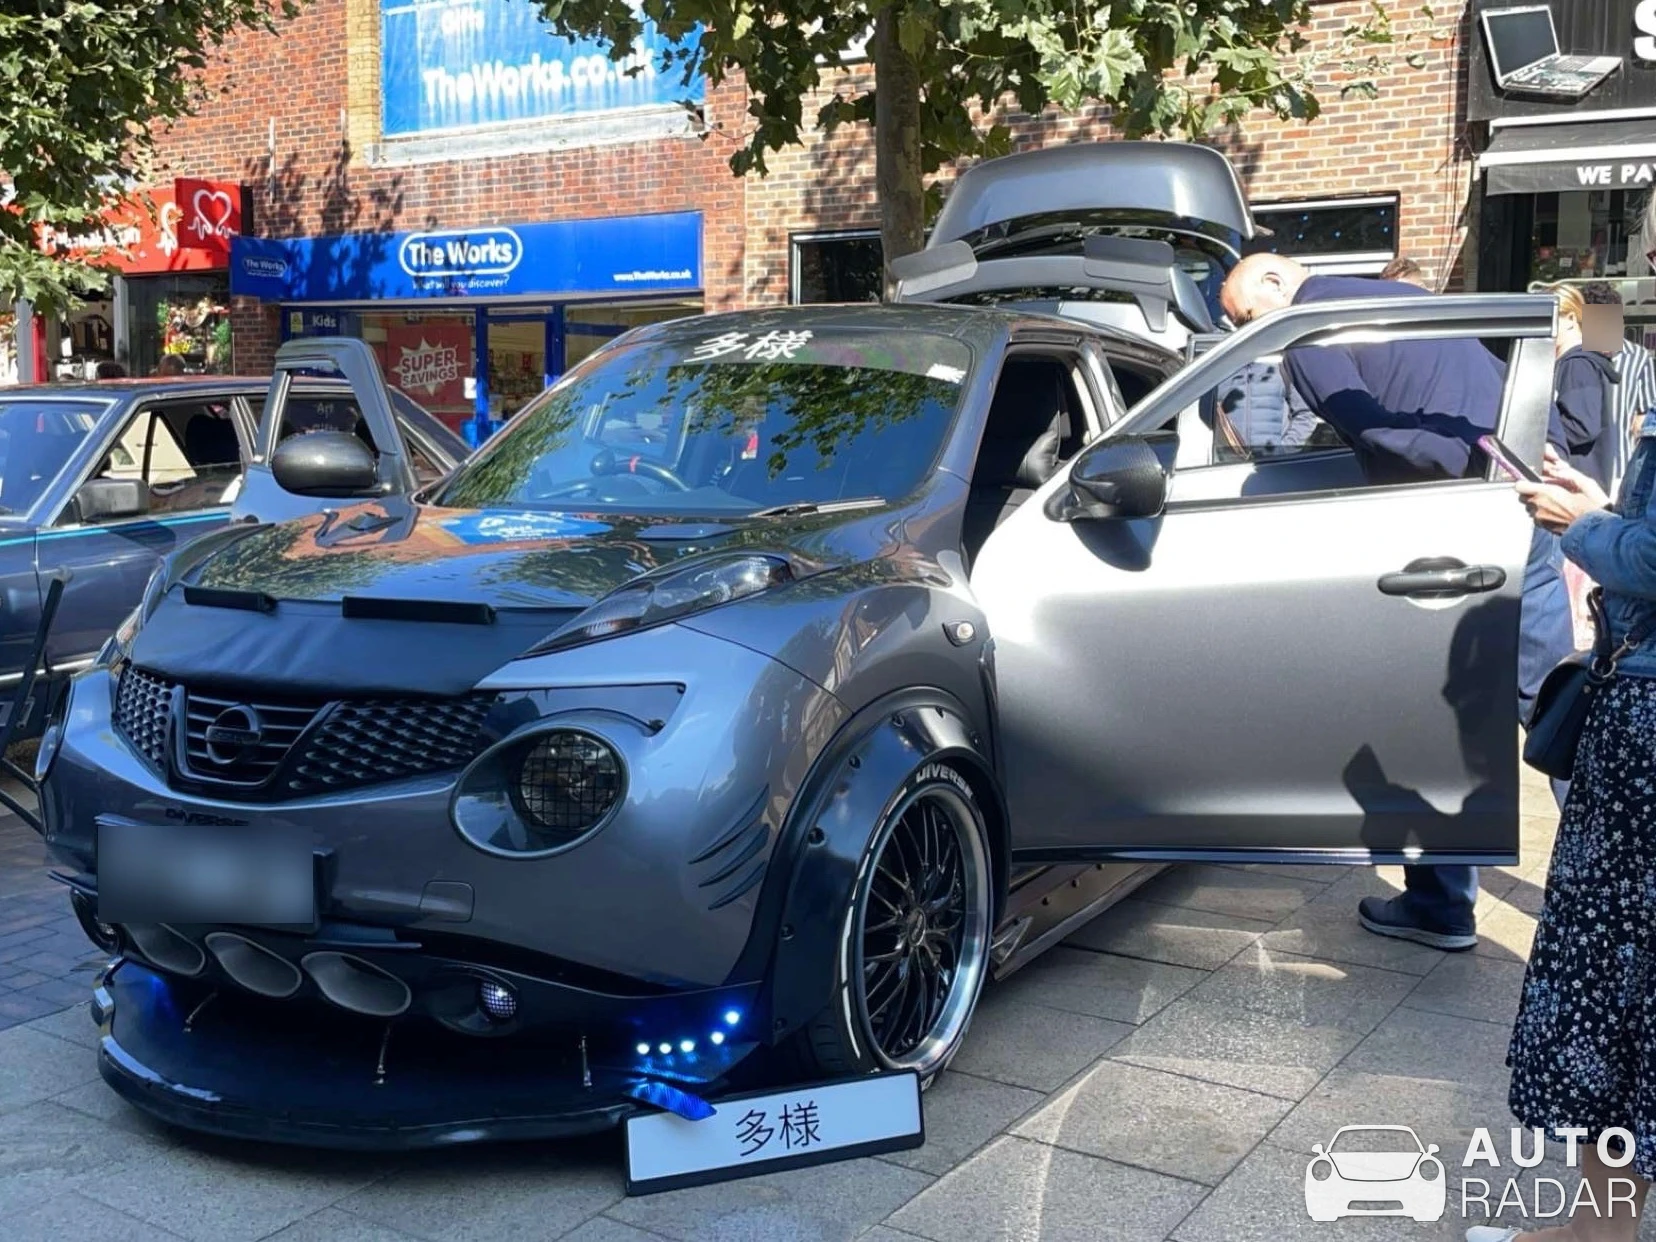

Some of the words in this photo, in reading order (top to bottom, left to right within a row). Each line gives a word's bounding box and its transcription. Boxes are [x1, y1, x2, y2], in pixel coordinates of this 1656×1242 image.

[423, 37, 655, 102] TheWorks.co.uk
[1576, 165, 1612, 185] WE
[408, 241, 445, 267] The
[446, 237, 514, 265] Works
[312, 314, 337, 328] Kids
[684, 330, 814, 363] 多様
[402, 350, 455, 374] SUPER
[403, 366, 456, 387] SAVINGS
[736, 1100, 821, 1157] 多様
